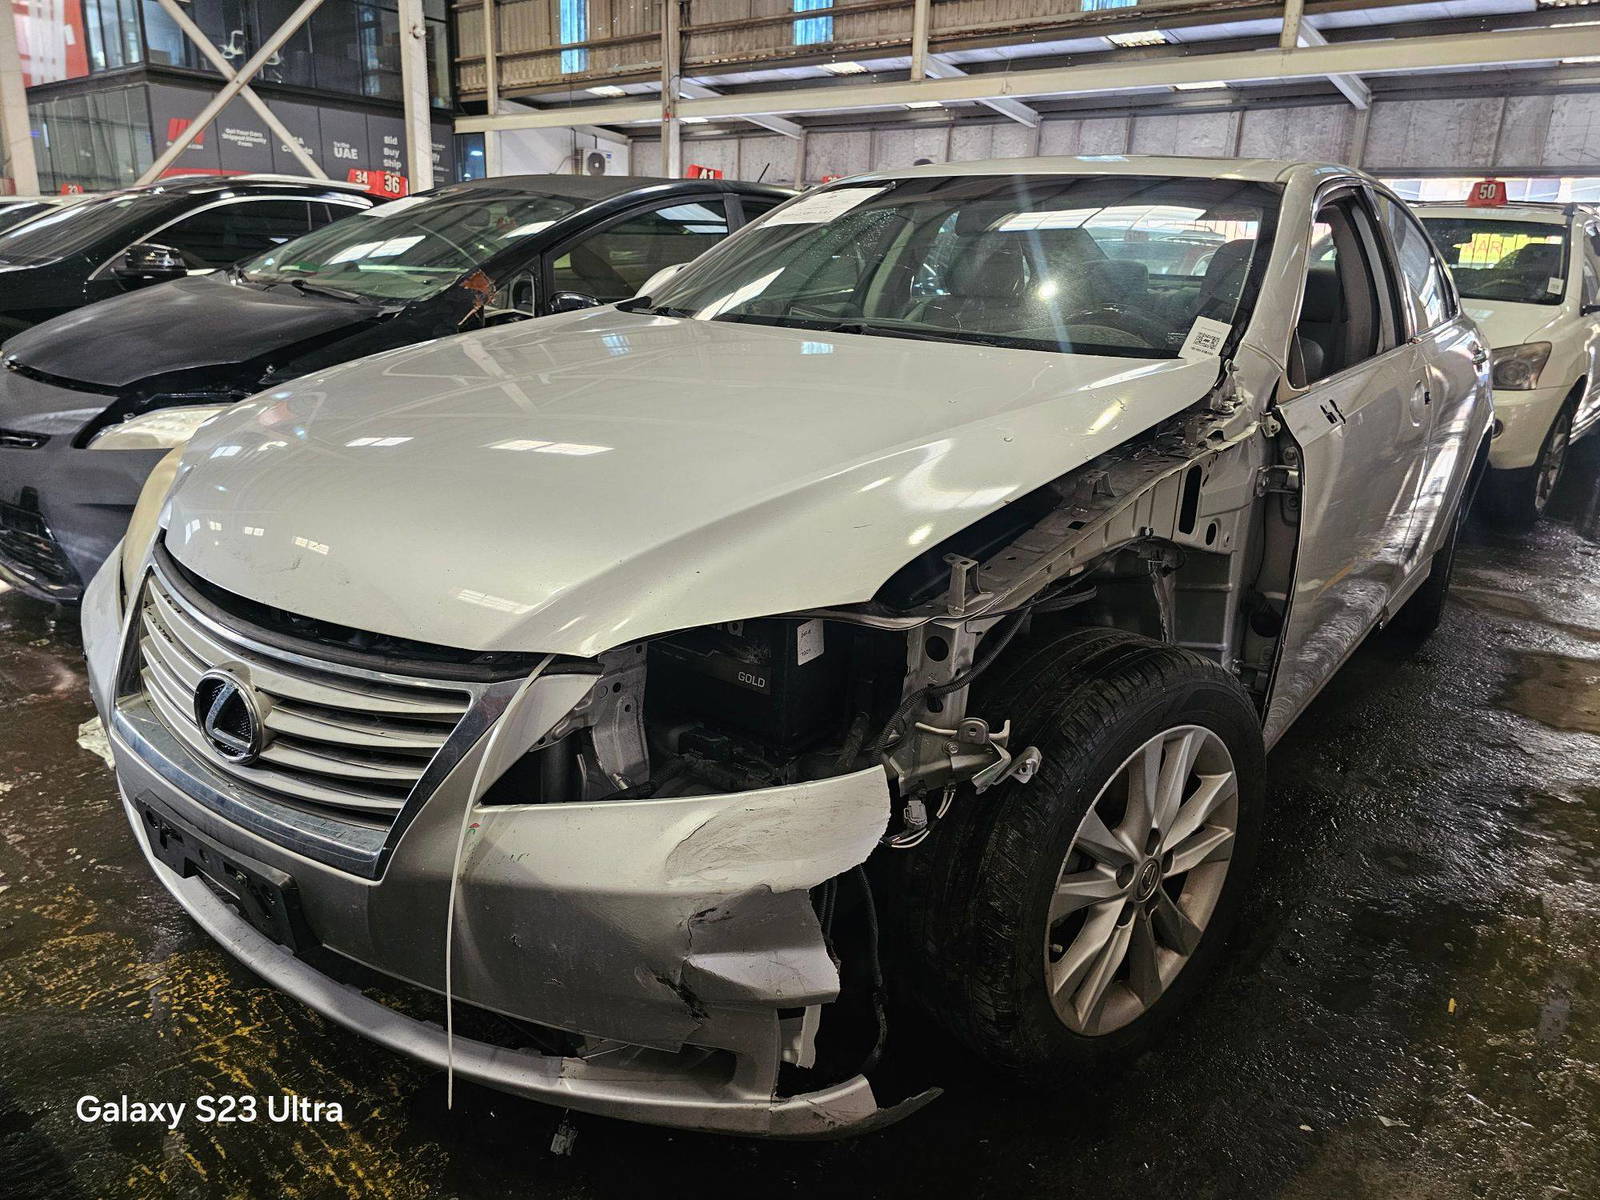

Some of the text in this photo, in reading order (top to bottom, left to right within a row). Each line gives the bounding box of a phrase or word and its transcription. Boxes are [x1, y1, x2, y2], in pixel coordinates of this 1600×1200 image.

[383, 135, 398, 145] Bid
[334, 147, 358, 160] UAE
[383, 147, 400, 158] Buy
[383, 159, 401, 170] Ship
[355, 170, 368, 184] 34
[384, 174, 400, 194] 36
[1479, 184, 1497, 200] 50
[737, 671, 766, 688] GOLD
